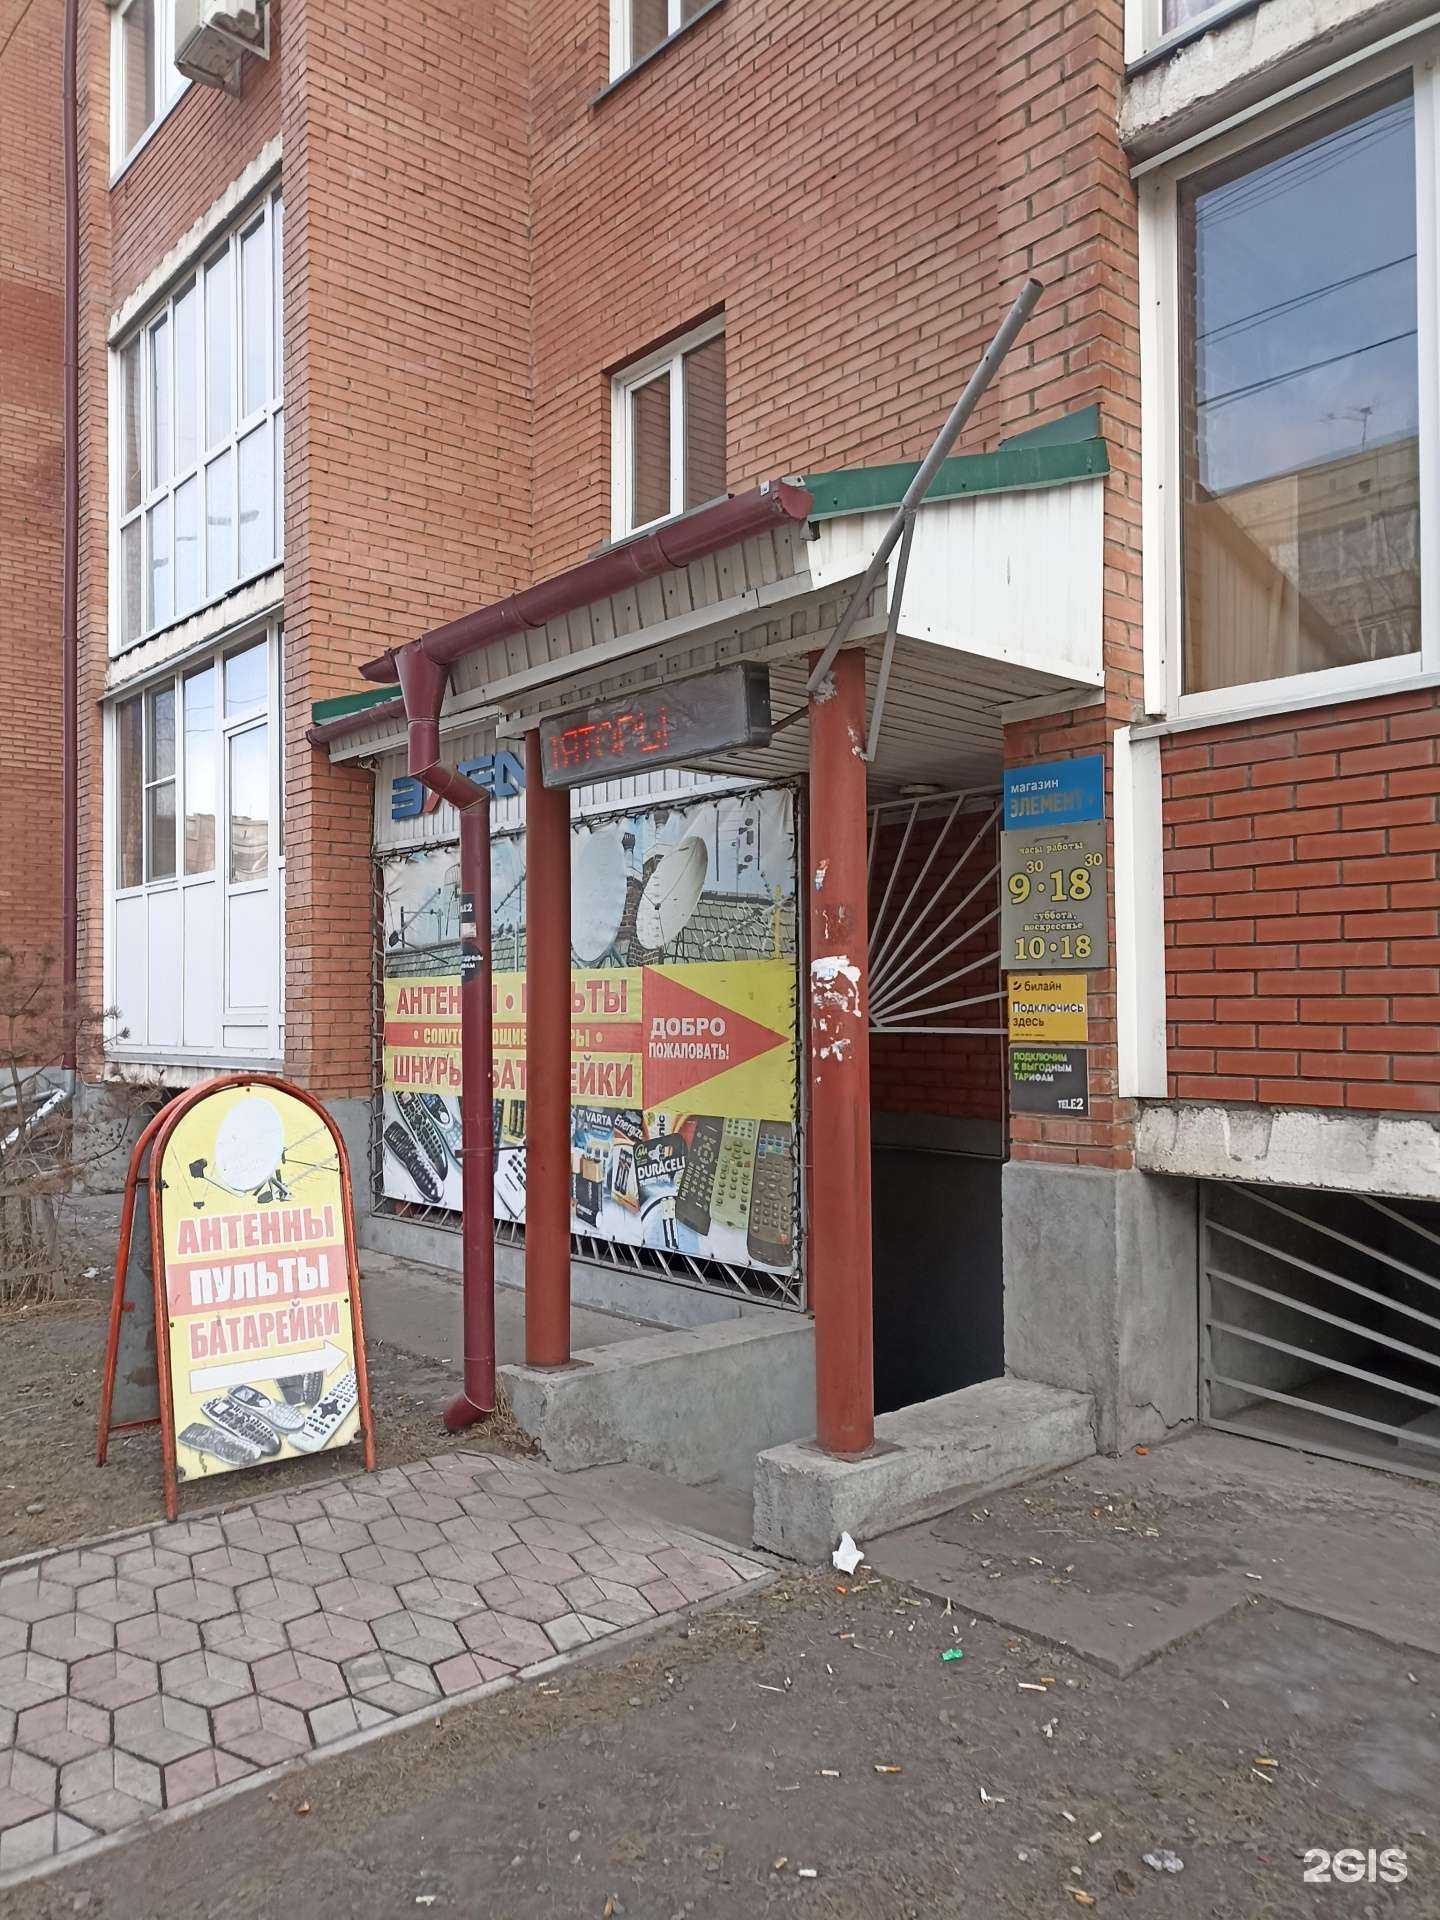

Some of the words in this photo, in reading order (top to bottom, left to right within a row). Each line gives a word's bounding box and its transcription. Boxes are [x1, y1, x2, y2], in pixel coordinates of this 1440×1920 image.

[1011, 779, 1059, 793] магазин
[1018, 844, 1042, 855] часы
[1047, 841, 1083, 855] работы
[1009, 872, 1031, 904] 9
[1026, 860, 1044, 874] 30
[1050, 867, 1092, 901] 18
[1084, 853, 1103, 867] 30
[1024, 981, 1061, 991] билайн
[1012, 1001, 1084, 1014] Подключись
[650, 1017, 726, 1040] ДОБРО
[1013, 1017, 1044, 1028] здесь
[648, 1041, 730, 1061] ПОЖАЛОВАТЬ!
[1013, 1052, 1067, 1062] ПОДКЛЮЧИМ
[1013, 1063, 1020, 1071] К
[1022, 1063, 1072, 1072] ВЫГОДНЫМ
[1014, 1073, 1054, 1082] ТАРИФАМ
[1057, 1098, 1083, 1110] TELE2
[585, 1111, 612, 1127] VARTA
[177, 1205, 335, 1256] АНТЕННЫ
[188, 1253, 330, 1306] ПУЛЬТЫ
[189, 1300, 341, 1362] БАТАРЕЙКИ
